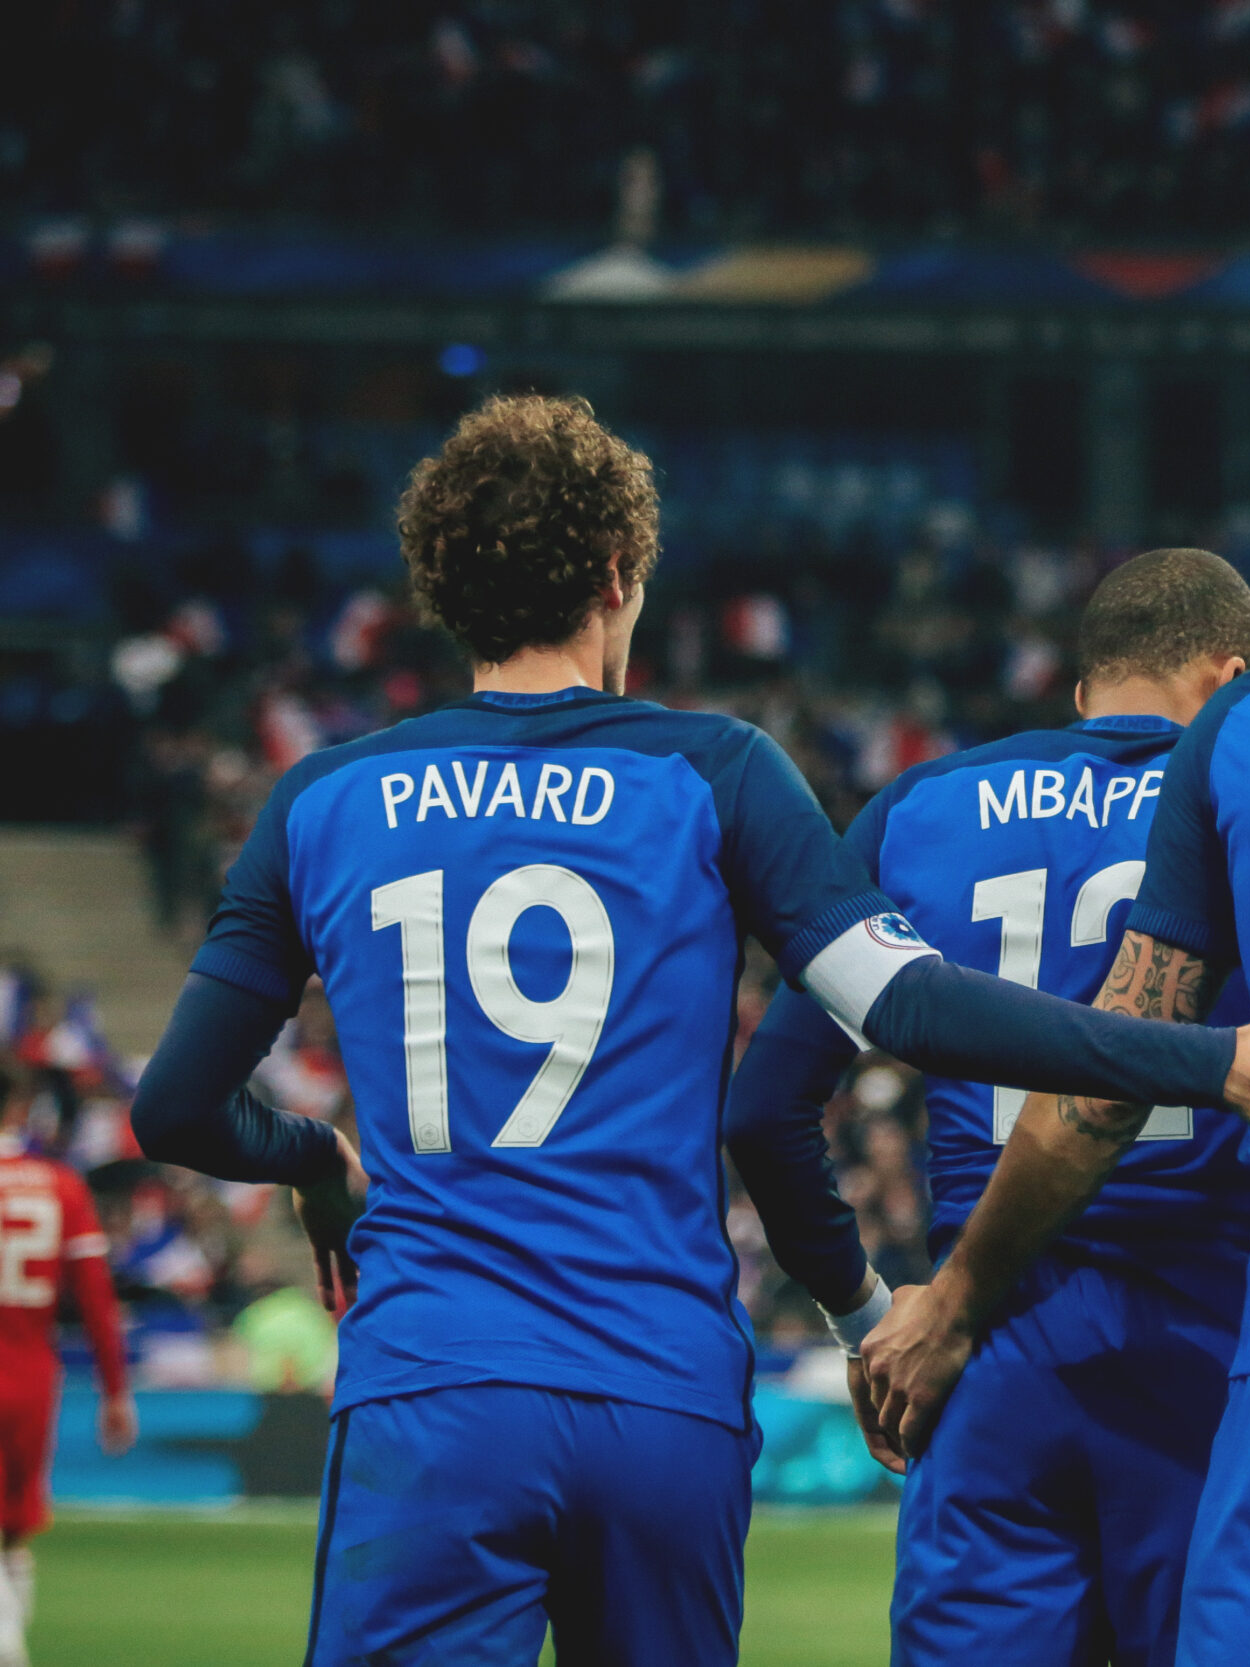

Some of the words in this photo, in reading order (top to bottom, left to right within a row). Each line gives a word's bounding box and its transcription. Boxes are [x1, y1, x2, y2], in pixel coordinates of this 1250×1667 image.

[380, 760, 615, 829] PAVARD
[978, 766, 1165, 830] MBAPP
[370, 863, 615, 1154] 19
